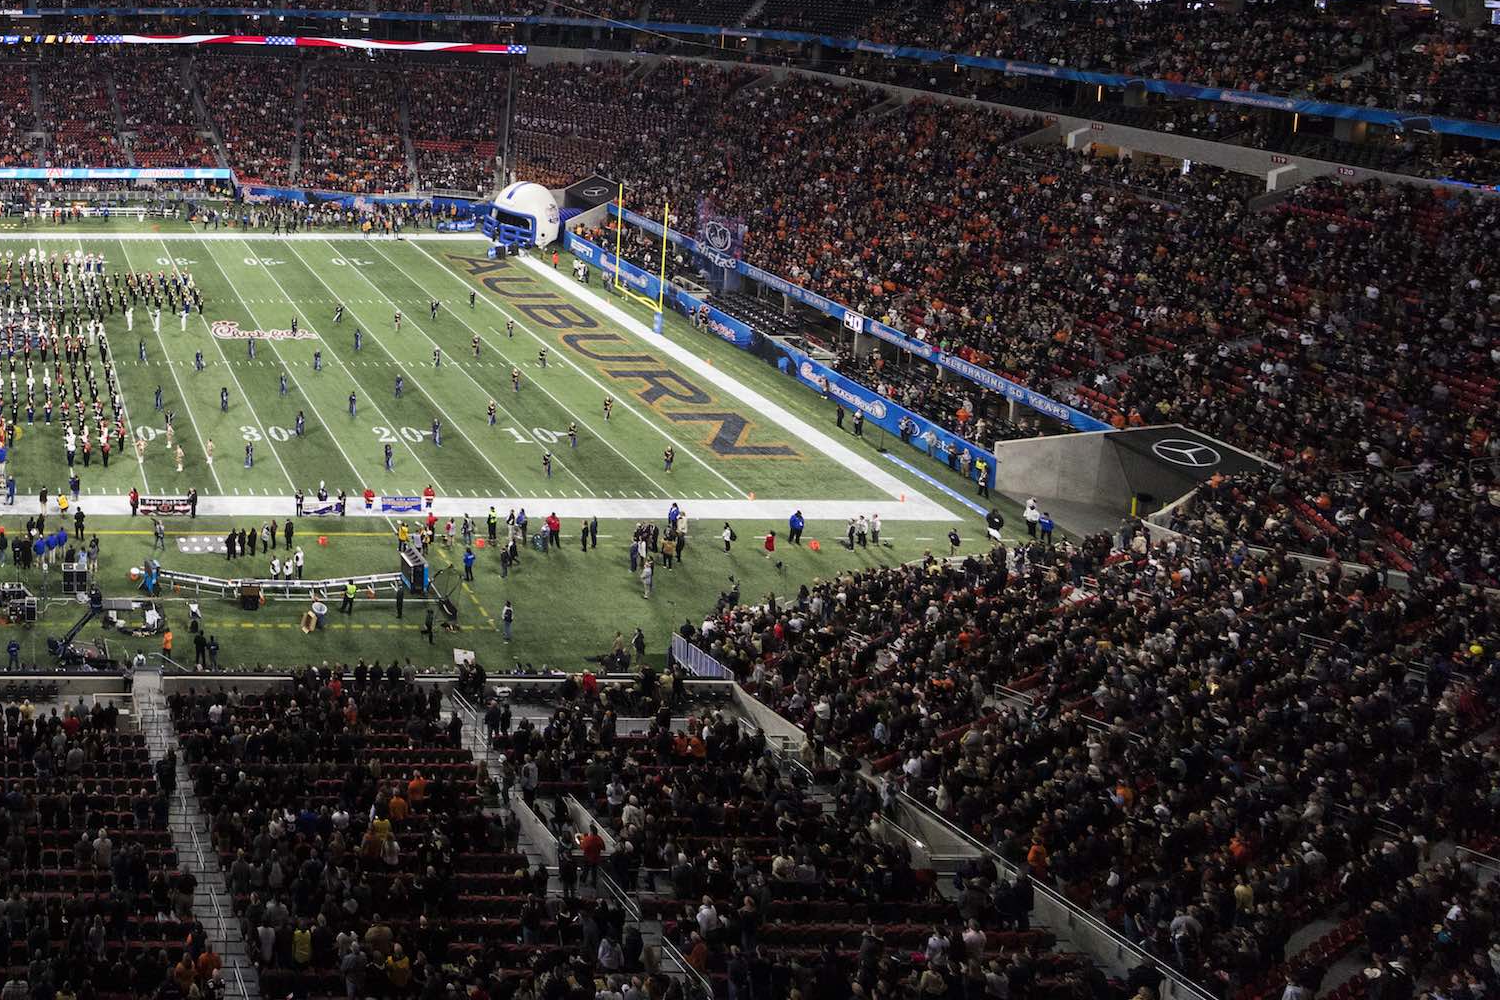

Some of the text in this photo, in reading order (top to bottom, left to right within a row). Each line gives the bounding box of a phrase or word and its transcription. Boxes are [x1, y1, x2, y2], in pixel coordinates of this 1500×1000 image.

[1339, 167, 1354, 176] 120
[845, 313, 862, 331] 40
[444, 252, 802, 459] AUBURN
[938, 353, 1070, 420] CELEBRATING 50 YEARS
[239, 425, 289, 442] 30
[372, 426, 424, 443] 20
[501, 427, 558, 444] 10
